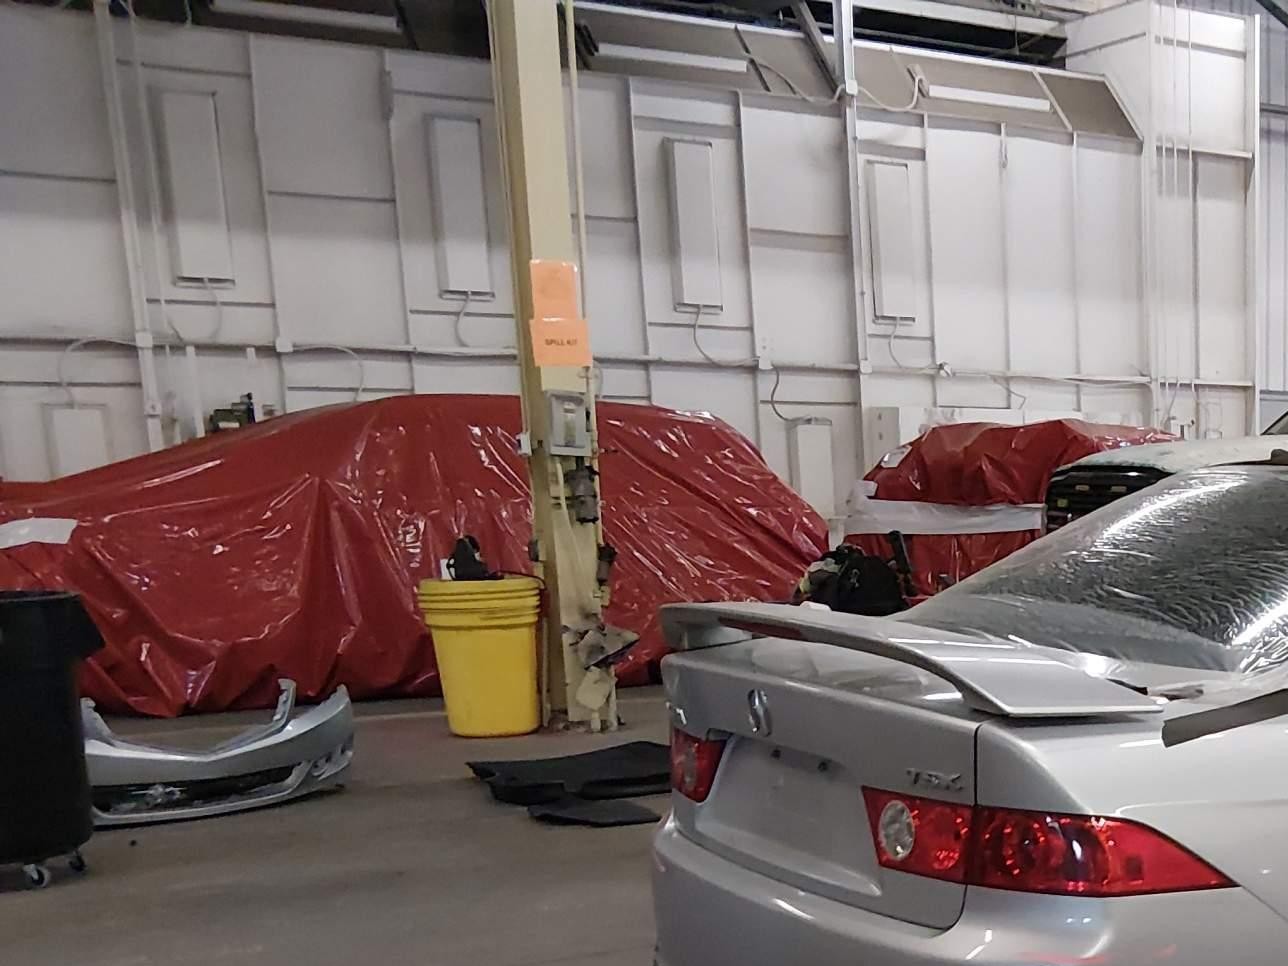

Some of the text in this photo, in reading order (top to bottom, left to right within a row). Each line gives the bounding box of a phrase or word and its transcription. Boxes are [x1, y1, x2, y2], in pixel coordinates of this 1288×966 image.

[544, 338, 578, 347] SPILL KIT
[905, 768, 964, 791] TSX
